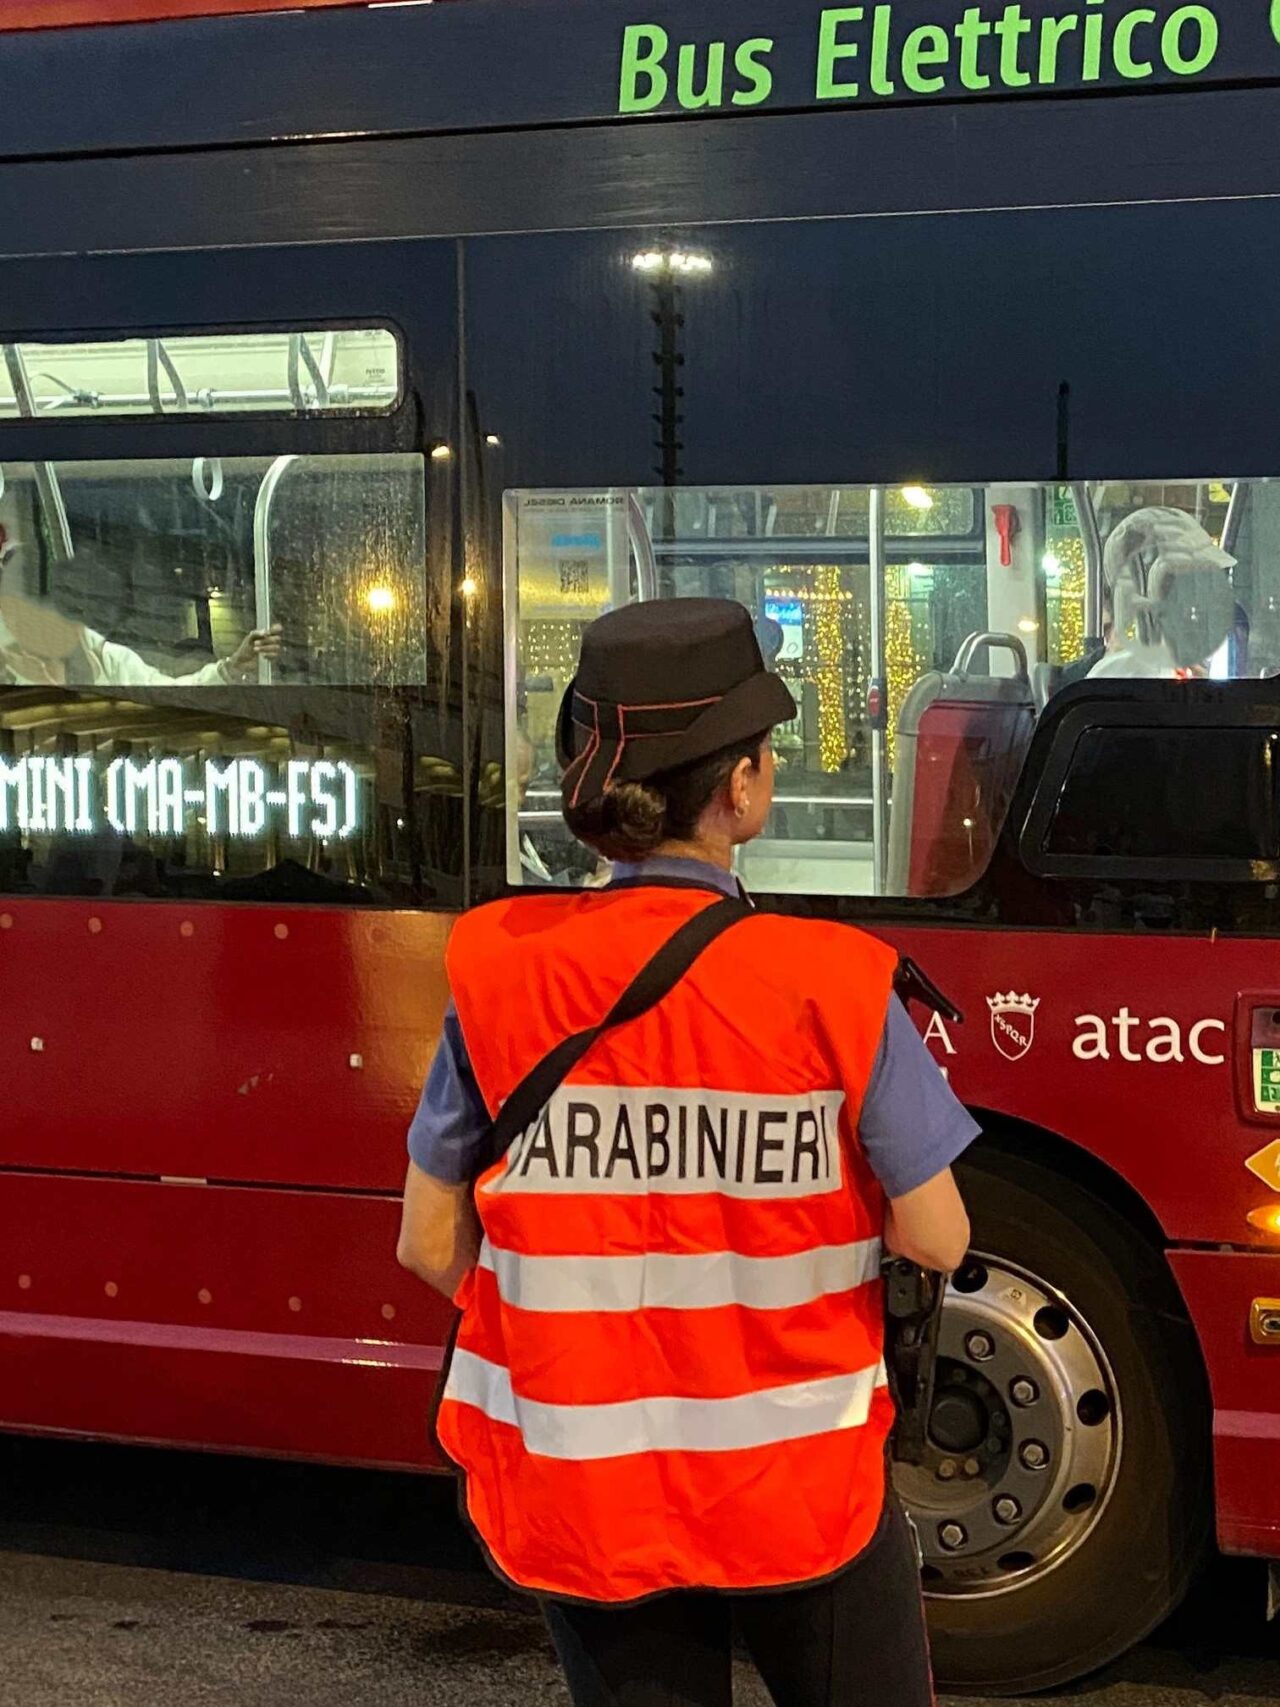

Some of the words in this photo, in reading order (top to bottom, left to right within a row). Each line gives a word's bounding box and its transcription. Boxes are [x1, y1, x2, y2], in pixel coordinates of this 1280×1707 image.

[618, 24, 773, 113] Bus
[815, 0, 1219, 99] Elettrico
[1072, 1006, 1226, 1066] atac
[506, 1100, 831, 1185] ARABINIERI
